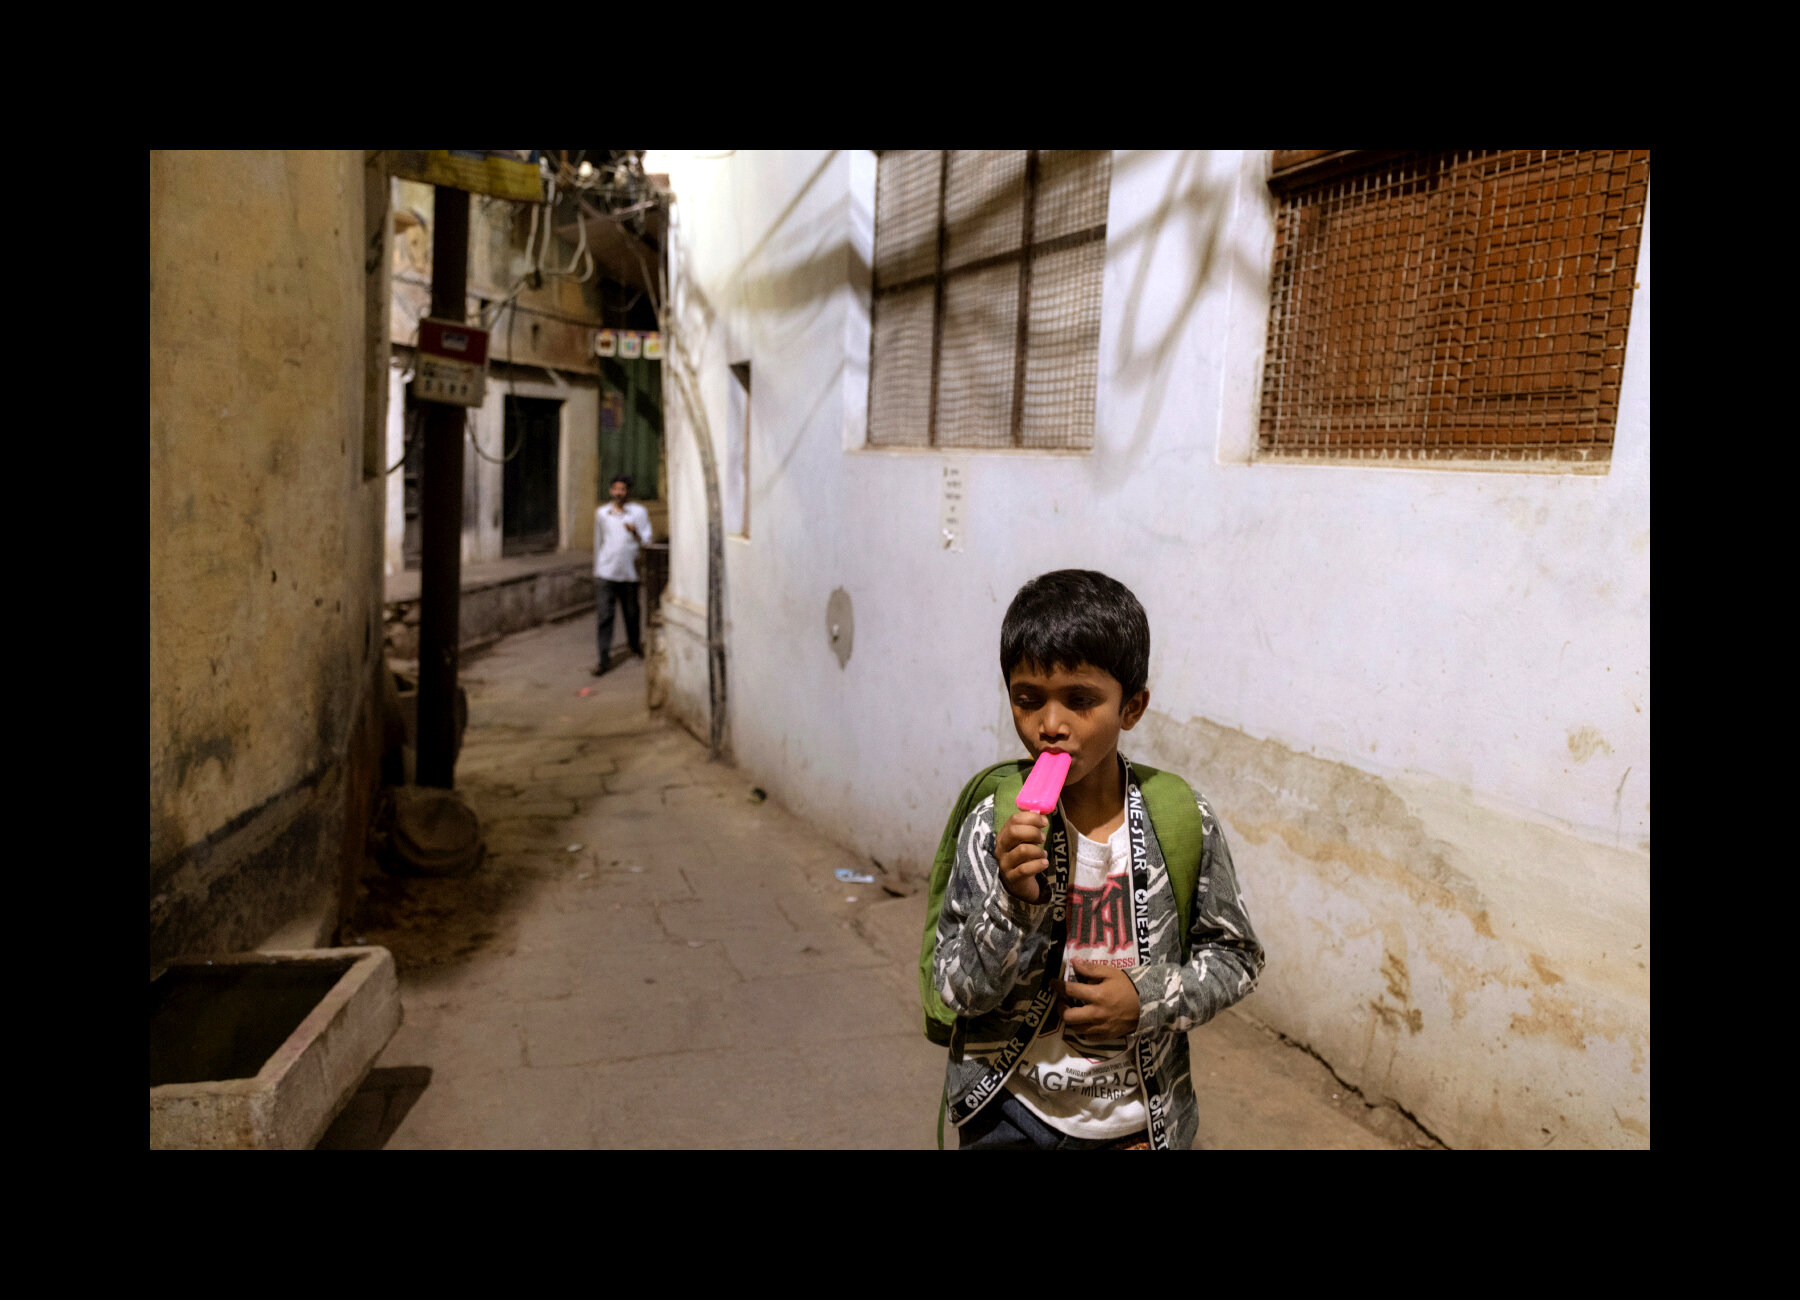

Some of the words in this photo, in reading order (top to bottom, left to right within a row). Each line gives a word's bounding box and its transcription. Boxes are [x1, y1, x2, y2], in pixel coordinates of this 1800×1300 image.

[1128, 784, 1147, 871] ONE-STAR
[1053, 831, 1069, 922] ONE-STAR
[1134, 888, 1153, 967] ONE-STA
[965, 1037, 1024, 1109] ONE-STAR
[1149, 1094, 1169, 1150] ONE-ST
